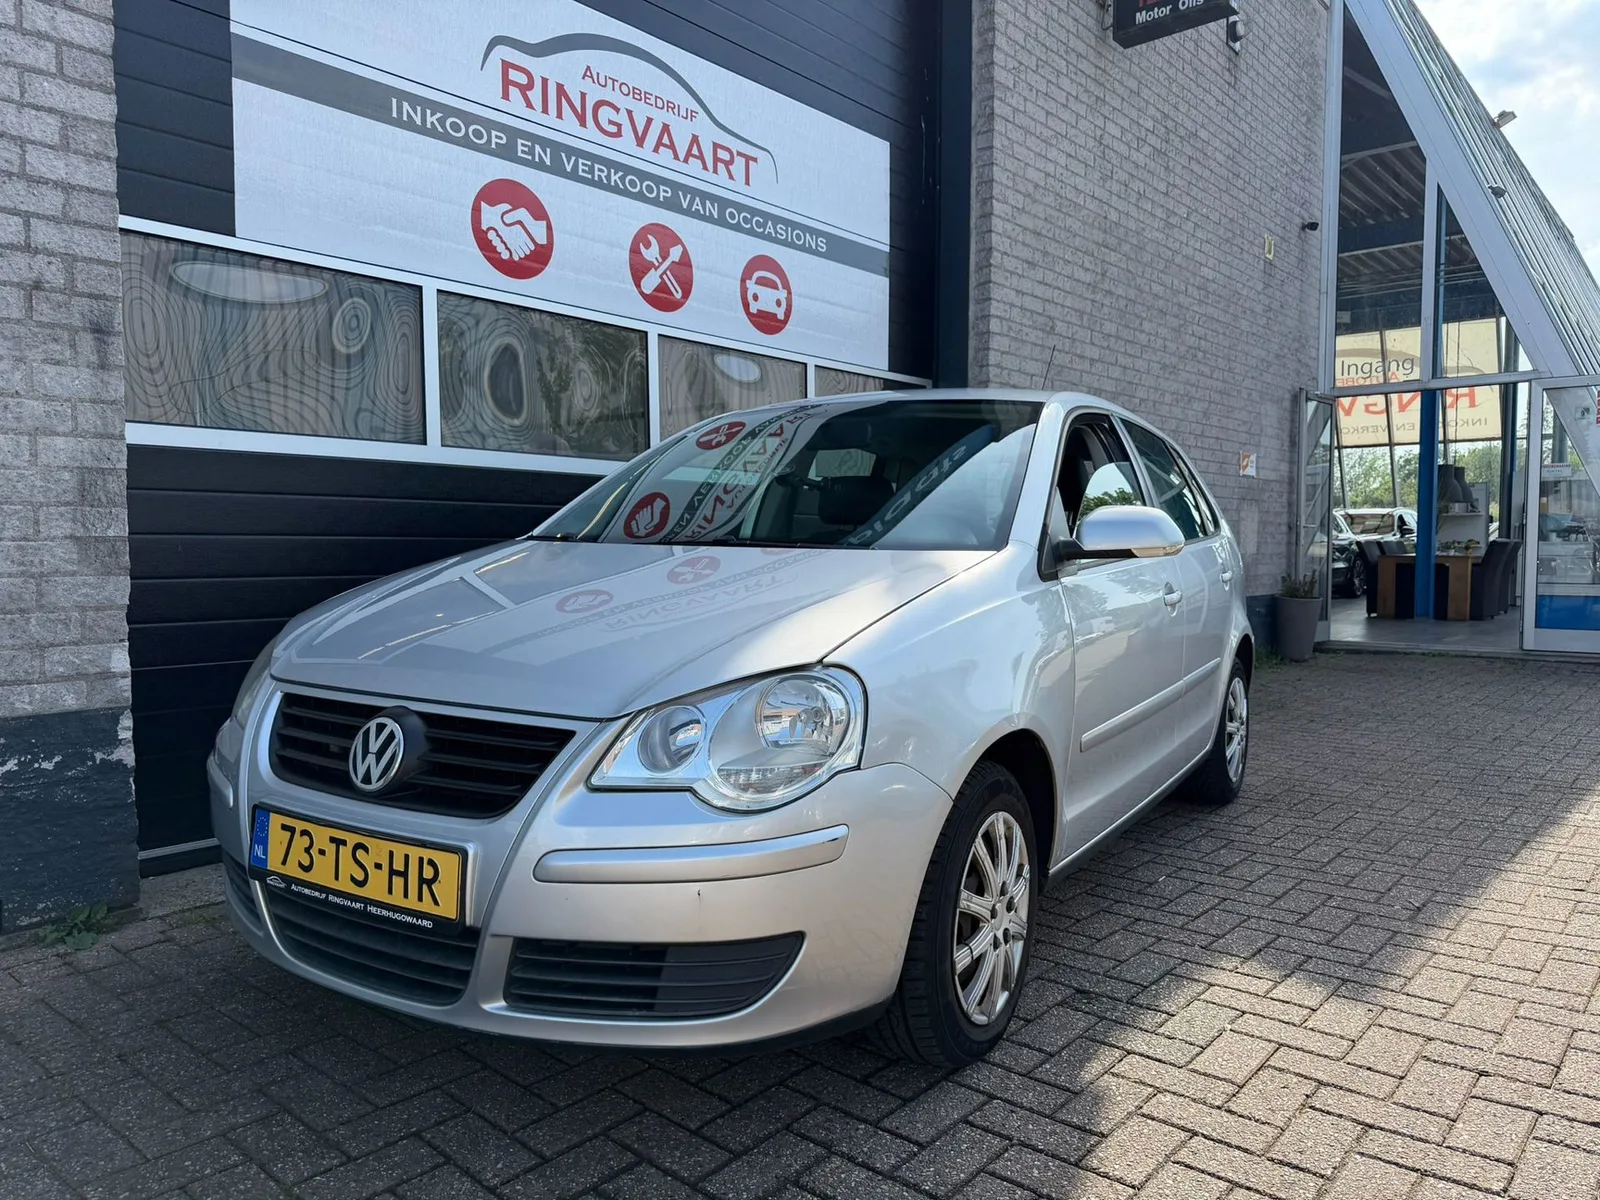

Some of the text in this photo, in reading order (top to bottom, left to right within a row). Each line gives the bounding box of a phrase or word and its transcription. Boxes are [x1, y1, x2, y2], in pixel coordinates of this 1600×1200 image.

[1135, 4, 1172, 25] Motor
[581, 64, 700, 123] AUTOBEDRIJF
[499, 58, 759, 187] RINGVAART
[390, 97, 828, 254] INKOOP EN VERKOOP VAN OCCASIONS
[1341, 357, 1415, 379] Ingang
[254, 843, 266, 860] NL
[280, 823, 442, 907] 73-TS-HR
[290, 883, 433, 929] AUTOBEDRIJF RINGVAART HEERHUGOWAARD
